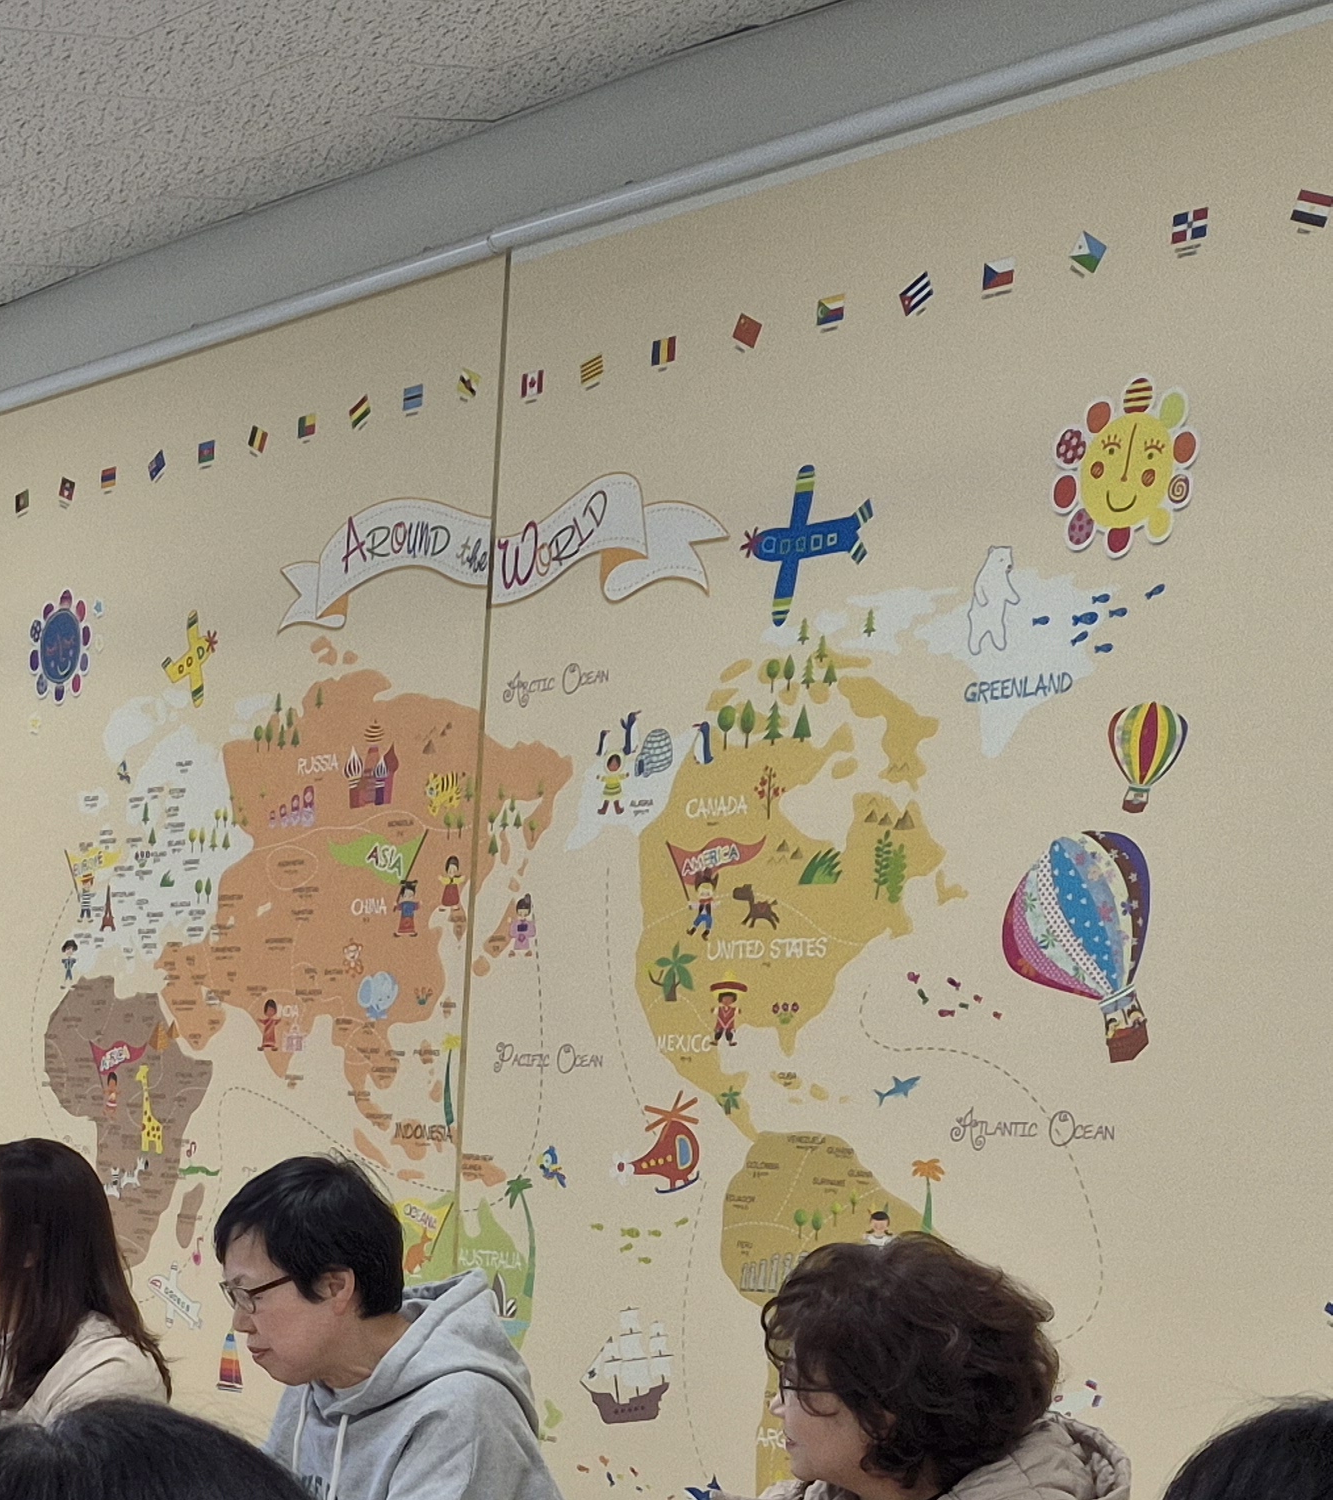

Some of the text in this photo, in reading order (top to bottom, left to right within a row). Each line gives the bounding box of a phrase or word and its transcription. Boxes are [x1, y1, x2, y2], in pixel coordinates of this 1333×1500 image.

[455, 536, 488, 573] the
[964, 672, 1073, 704] GREENLAND
[297, 754, 339, 775] RUSSIA
[686, 795, 748, 819] CANADA
[366, 842, 403, 880] ASIA
[681, 843, 740, 877] AMERICA
[707, 937, 829, 961] UNITED STATES
[657, 1034, 712, 1053] MEXICO
[394, 1122, 453, 1143] INDONESIA
[459, 1248, 522, 1271] AUSTRALIA
